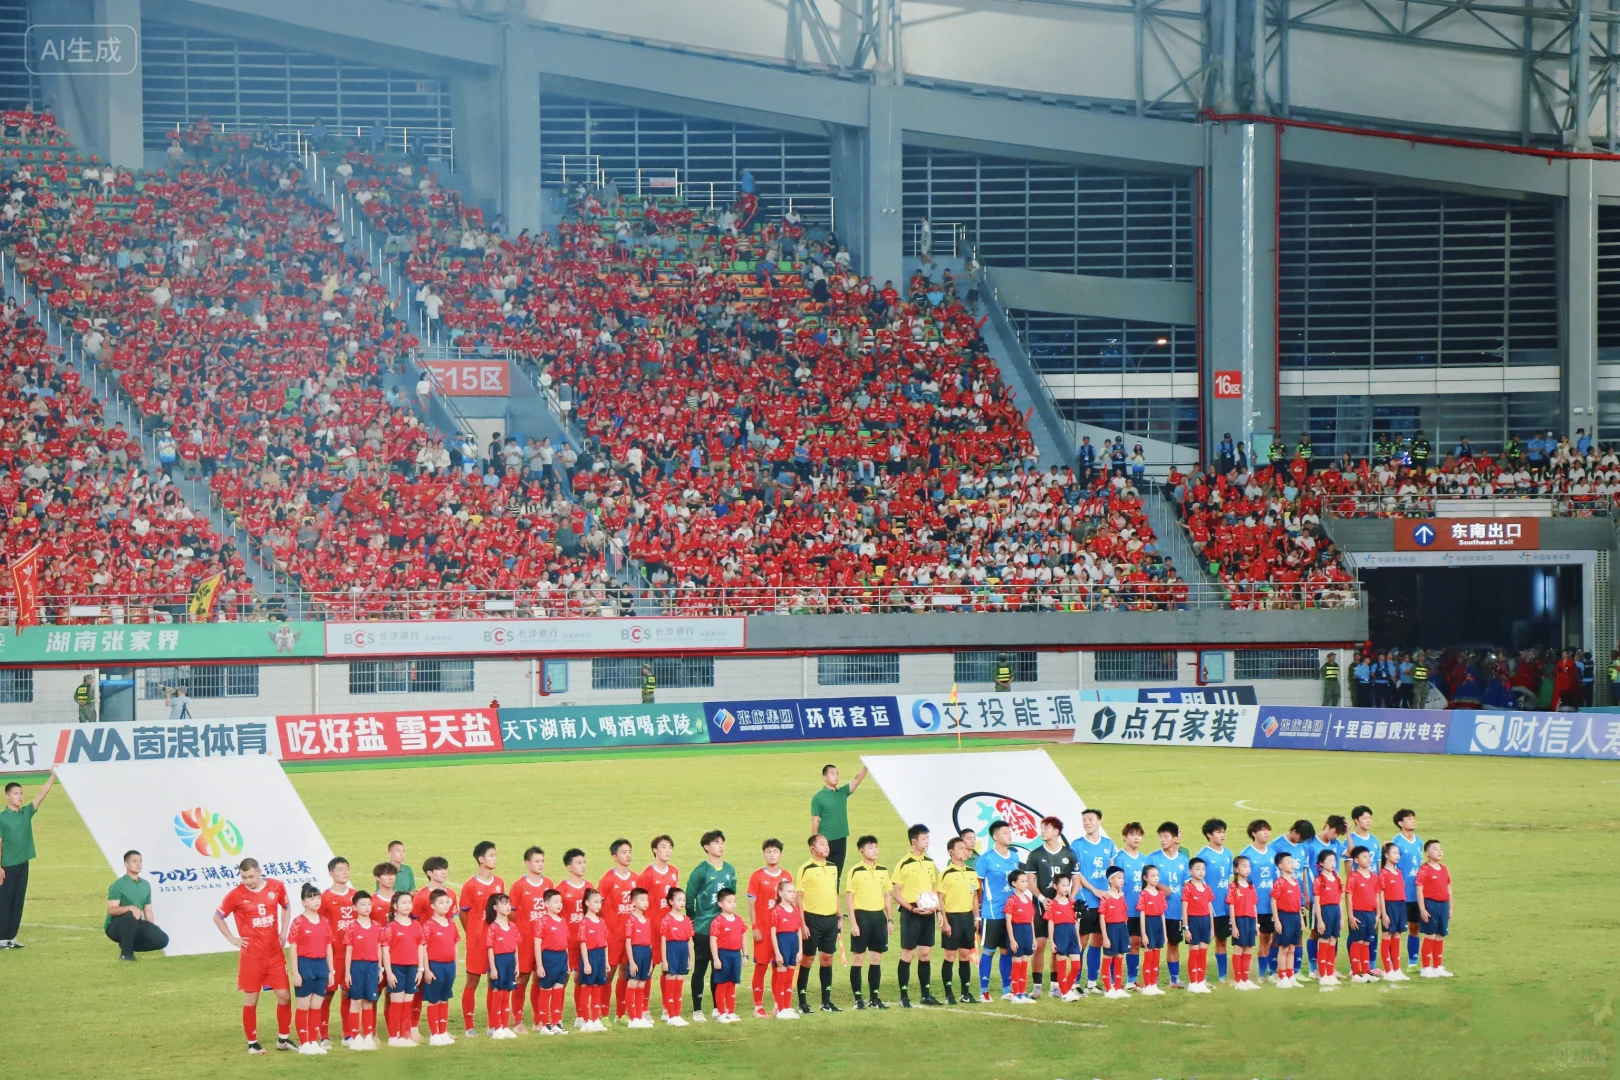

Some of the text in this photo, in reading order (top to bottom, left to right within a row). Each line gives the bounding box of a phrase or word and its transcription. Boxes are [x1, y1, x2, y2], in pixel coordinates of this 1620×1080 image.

[1215, 375, 1241, 395] 16区
[1451, 522, 1522, 538] 东南出口
[380, 631, 420, 641] 长沙银行
[484, 630, 515, 643] BCS
[519, 628, 558, 639] 长沙银行
[621, 628, 652, 641] BCS
[655, 626, 694, 636] 长沙银行
[45, 629, 180, 653] 湖南张家界
[344, 632, 375, 646] BCS
[805, 705, 891, 729] 环保客运
[942, 695, 1076, 729] 交投能源
[502, 712, 693, 742] 天下湖南人 喝酒喝武陵
[1120, 706, 1240, 743] 点石家装
[1332, 719, 1447, 741] 十里画廊观光电车
[132, 722, 268, 760] 茵浪体育
[285, 713, 495, 755] 吃好盐 雪天盐
[1093, 856, 1103, 869] 46
[150, 860, 311, 884] 2025 湖南球联赛
[1168, 871, 1178, 883] 14
[1260, 866, 1270, 878] 25
[187, 883, 222, 891] HUNAN
[257, 903, 267, 916] 6
[341, 906, 353, 919] 52
